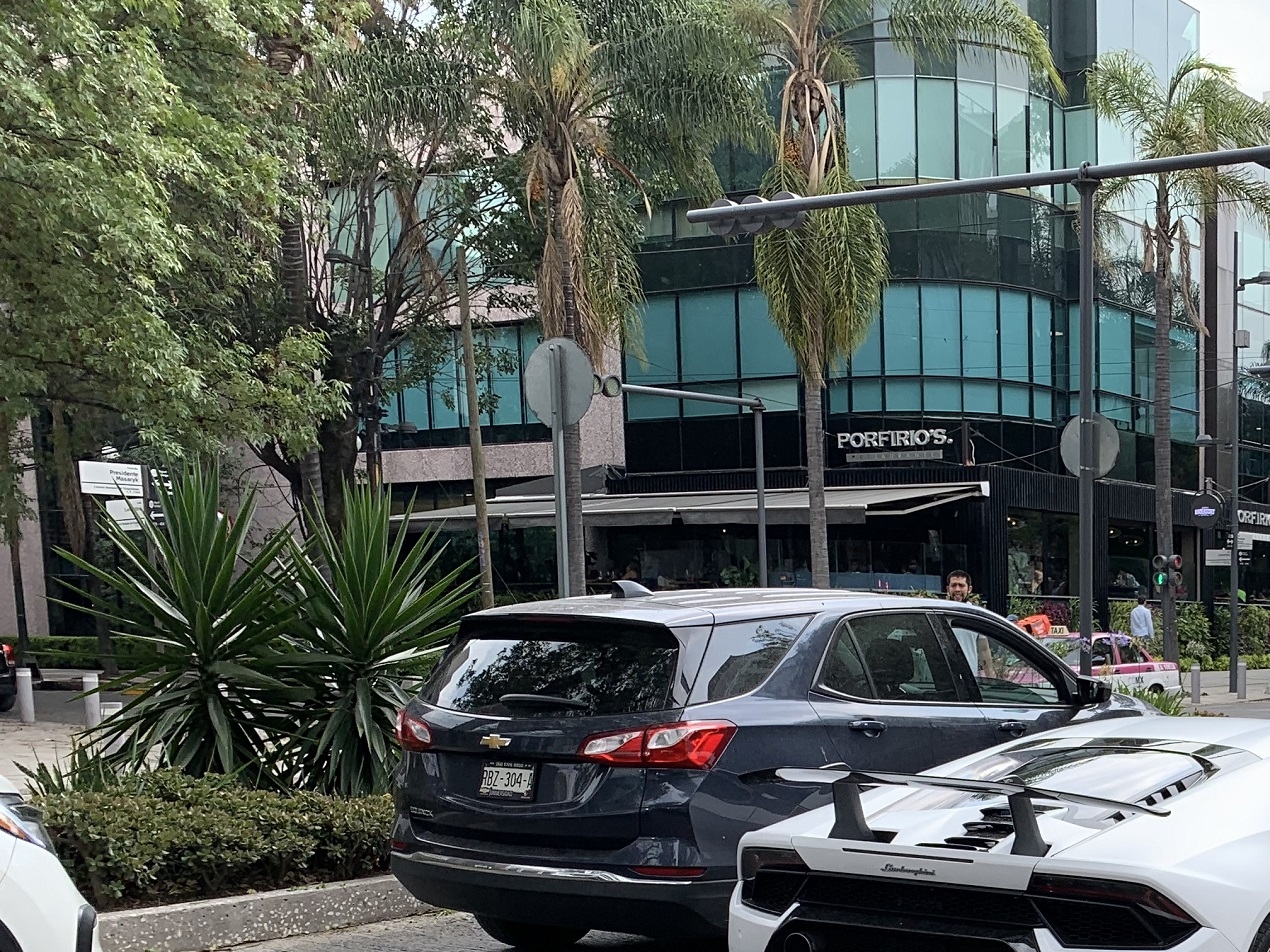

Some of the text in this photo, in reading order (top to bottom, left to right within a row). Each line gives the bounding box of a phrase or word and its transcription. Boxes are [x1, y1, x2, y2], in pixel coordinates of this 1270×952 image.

[109, 469, 138, 477] Presidente
[116, 475, 139, 483] Masaryk
[1050, 626, 1064, 634] TAXI
